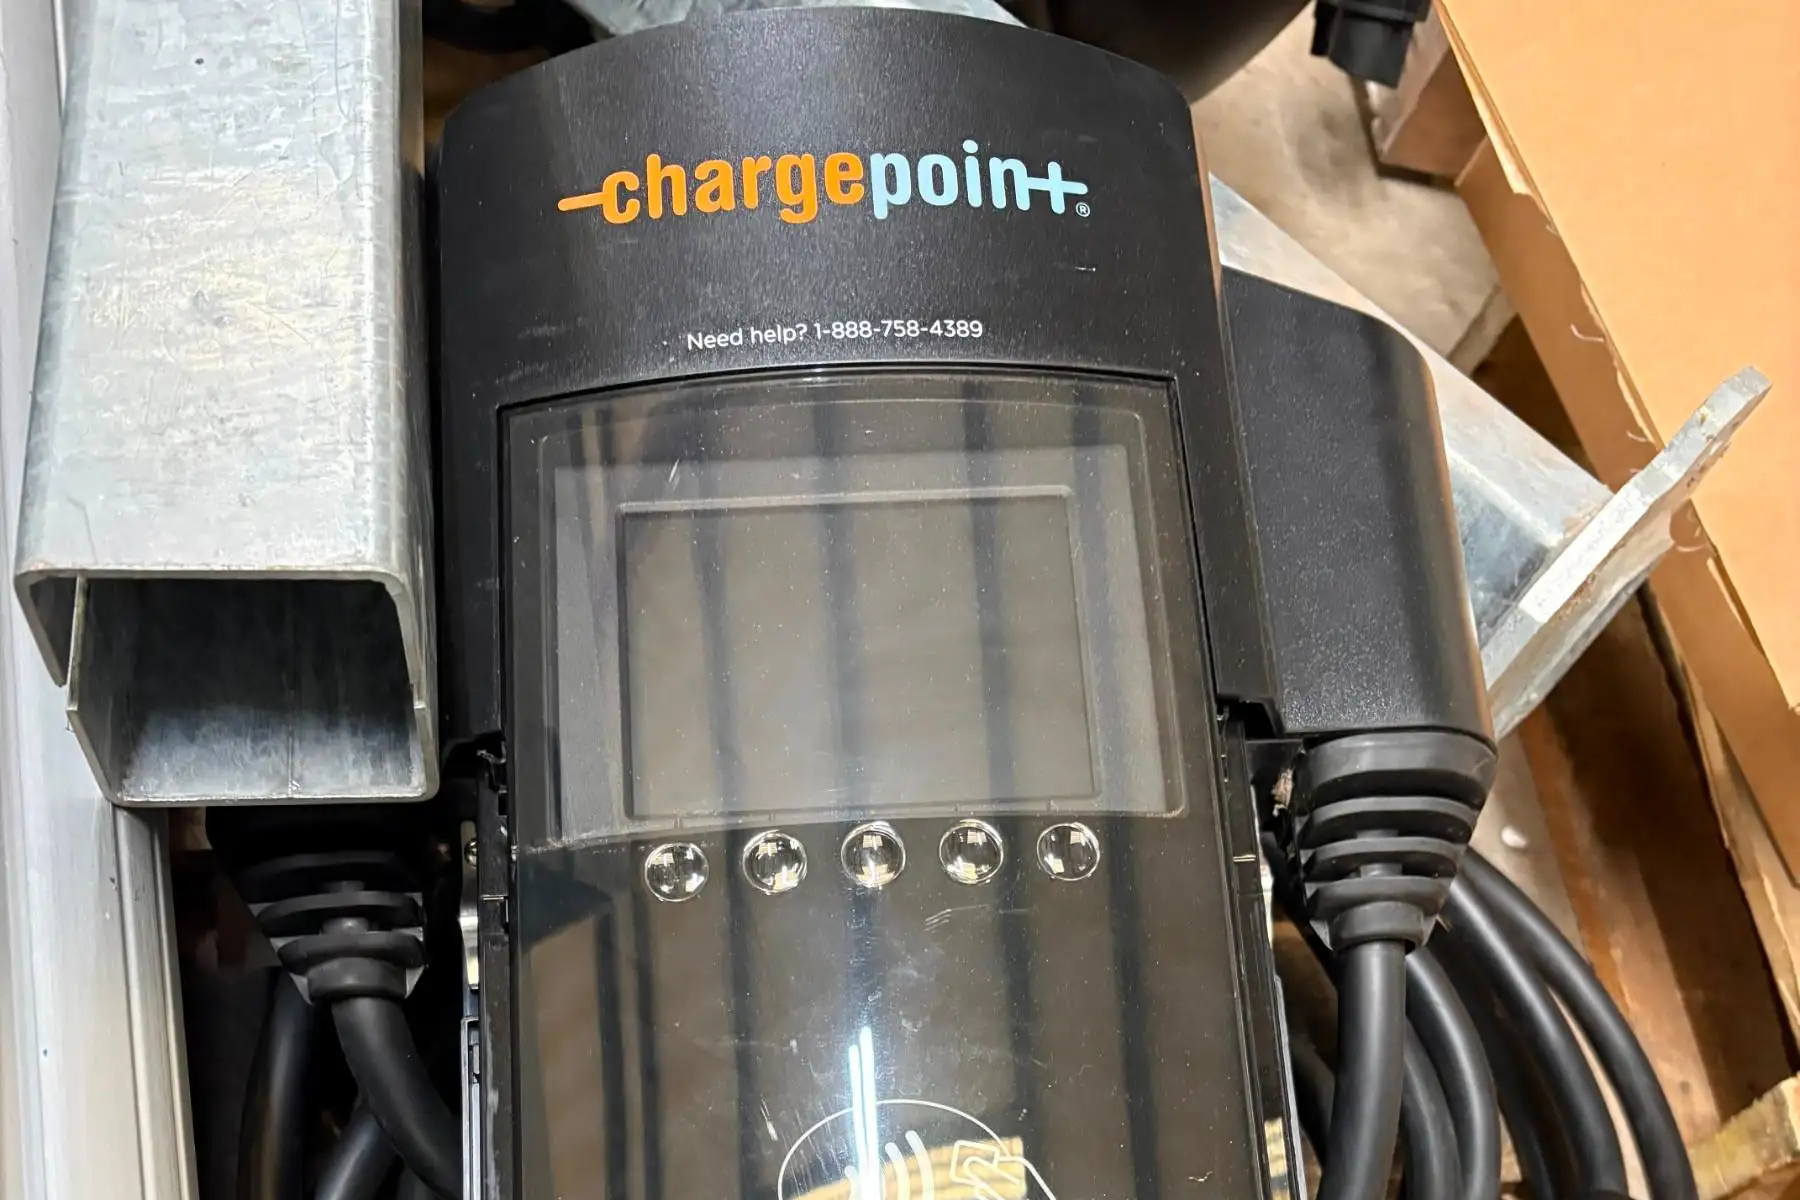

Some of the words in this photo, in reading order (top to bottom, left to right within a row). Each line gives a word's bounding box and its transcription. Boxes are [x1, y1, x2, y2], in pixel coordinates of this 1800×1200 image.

[687, 327, 743, 351] Need
[750, 323, 809, 346] help?
[812, 319, 984, 341] 1-888-758-4389
